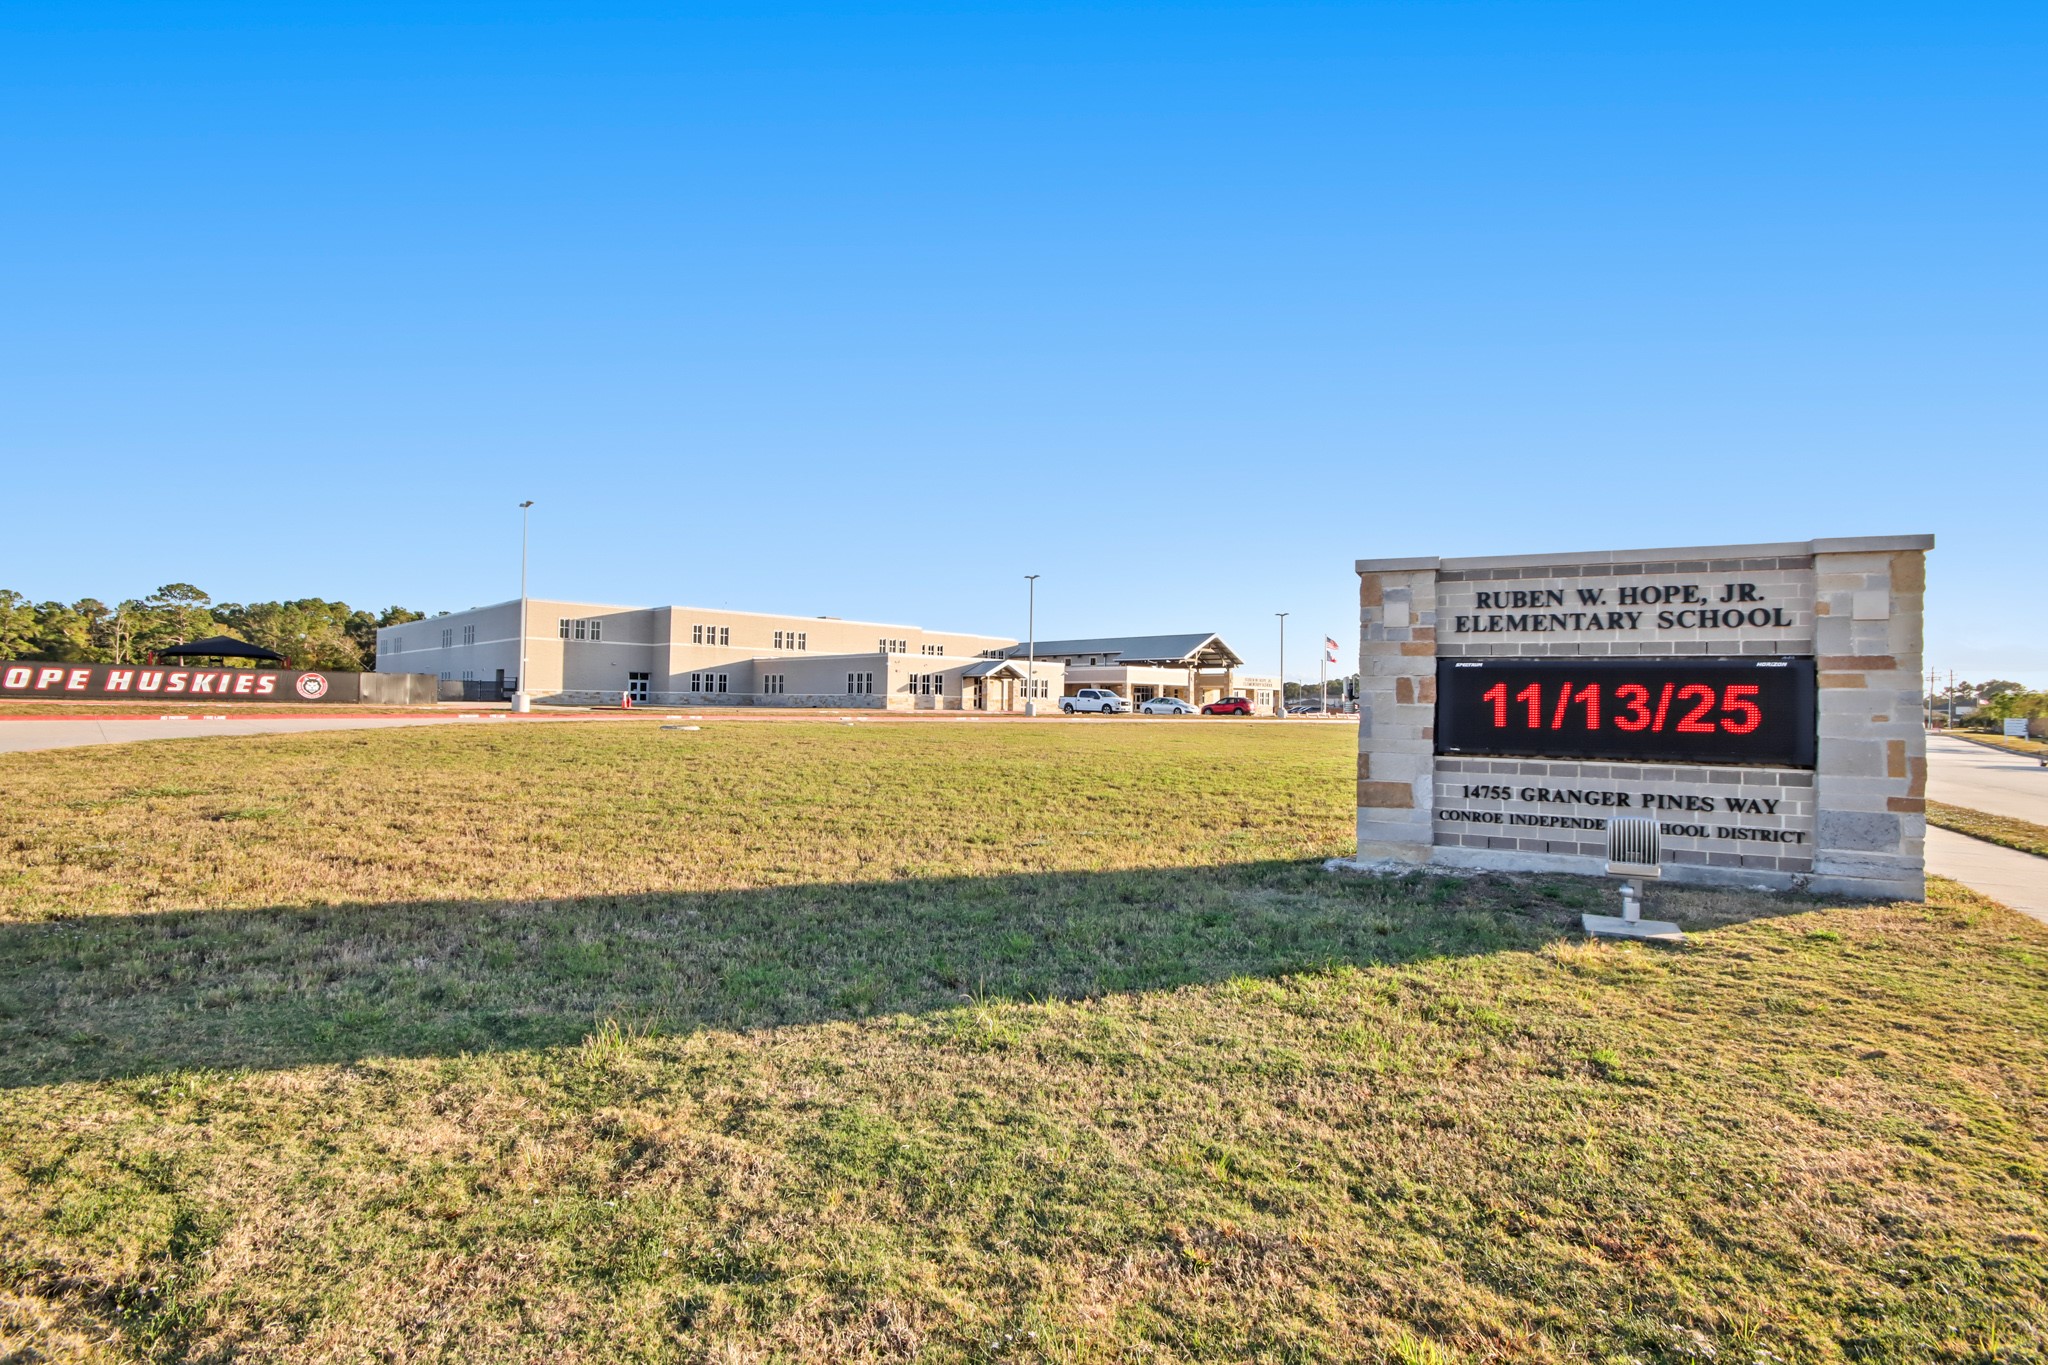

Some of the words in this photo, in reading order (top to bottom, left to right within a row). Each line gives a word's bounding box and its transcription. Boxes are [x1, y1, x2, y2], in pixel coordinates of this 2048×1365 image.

[1475, 589, 1565, 609] RUBEN
[1576, 588, 1606, 606] W.
[1618, 584, 1708, 606] HOPE,
[1719, 583, 1765, 603] JR.
[1455, 611, 1643, 633] ELEMENTARY
[1657, 607, 1793, 630] SCHOOL
[0, 664, 93, 691] OPE
[104, 669, 278, 695] HUSKIES
[1483, 681, 1763, 735] 11/13/25
[1463, 785, 1512, 800] 14755
[1520, 787, 1632, 807] GRANGER
[1641, 793, 1715, 812] PINES
[1724, 797, 1781, 815] WAY
[1439, 809, 1504, 824] CONROE
[1509, 813, 1607, 831] INDEPENDE
[1660, 823, 1711, 838] HOOL
[1717, 826, 1806, 844] DISTRICT
